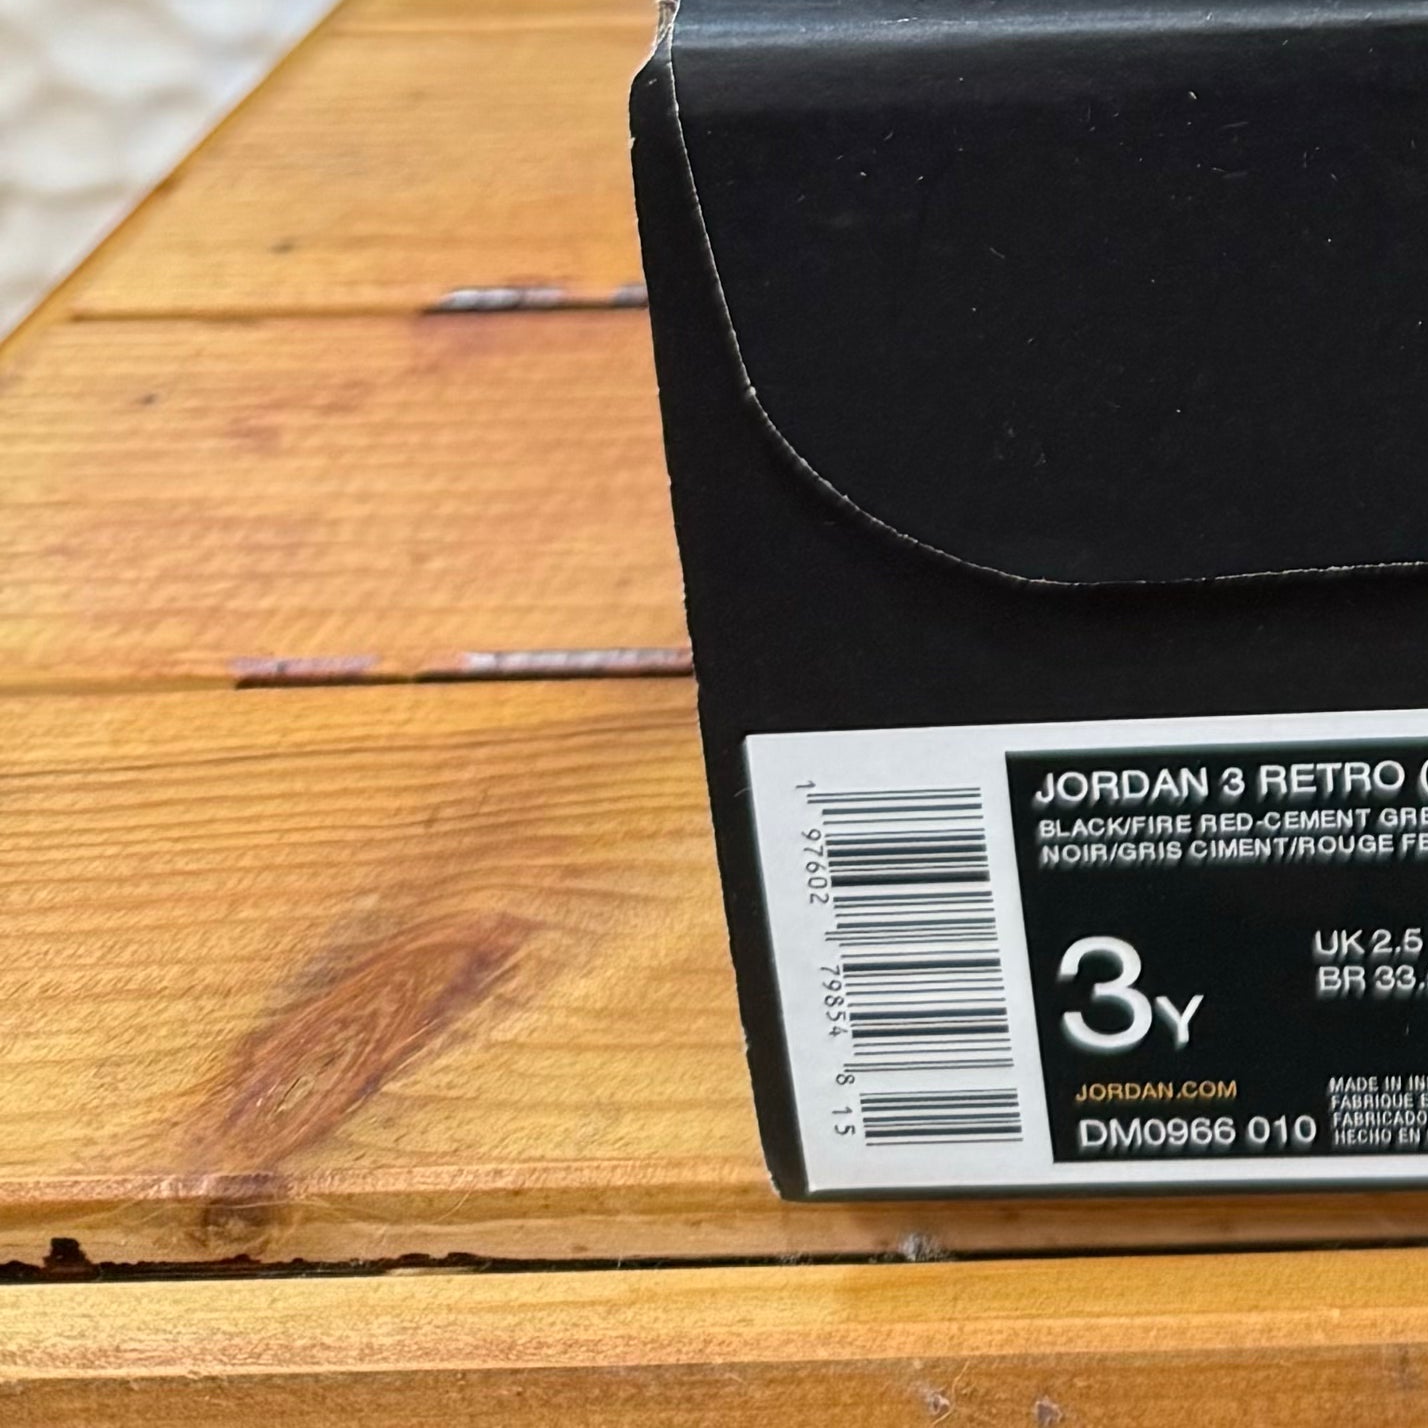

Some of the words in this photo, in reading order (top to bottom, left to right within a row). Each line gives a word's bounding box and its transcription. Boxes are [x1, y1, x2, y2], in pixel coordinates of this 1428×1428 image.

[1034, 766, 1209, 804] JORDAN
[1220, 766, 1246, 797] 3
[1258, 759, 1406, 796] RETRO
[1038, 813, 1193, 839] BLACK/FIRE
[1199, 808, 1372, 834] RED-CEMENT
[1040, 840, 1183, 864] NOIR/GRIS
[1190, 834, 1395, 859] CIMENT/ROUGE
[1314, 928, 1366, 956] UK
[1371, 927, 1424, 954] 2.5
[800, 828, 831, 905] 97602
[820, 964, 849, 1038] 79854
[835, 1073, 856, 1086] 8
[1317, 965, 1367, 992] BR
[1075, 1079, 1238, 1103] JORDAN.COM
[1329, 1076, 1379, 1093] MADE
[1385, 1075, 1402, 1092] IN
[1077, 1116, 1237, 1148] DM0966
[1247, 1114, 1317, 1145] 010
[1333, 1109, 1428, 1127] FABRICADO
[1334, 1127, 1393, 1145] HECHO
[1398, 1126, 1421, 1144] EN
